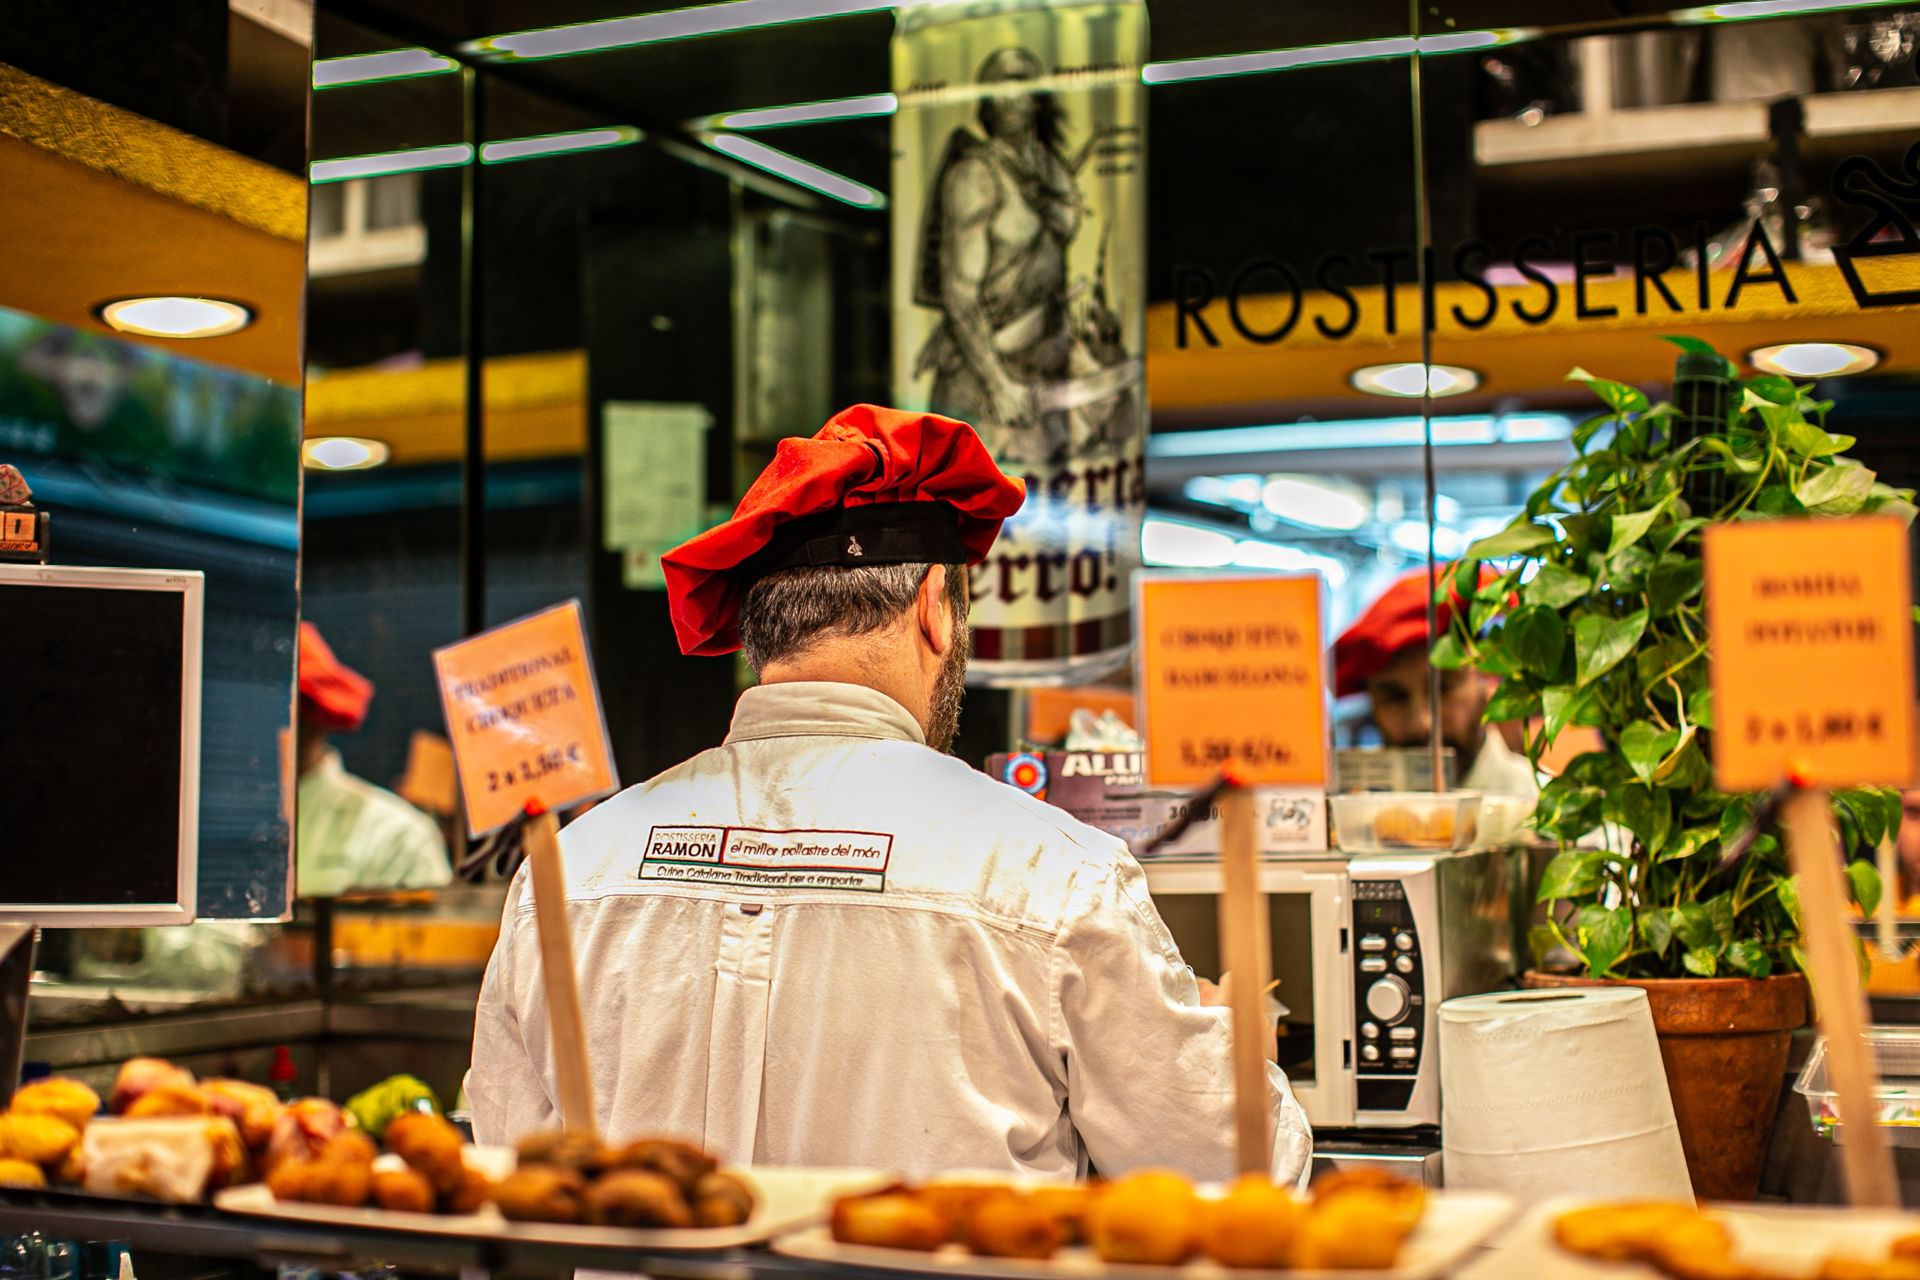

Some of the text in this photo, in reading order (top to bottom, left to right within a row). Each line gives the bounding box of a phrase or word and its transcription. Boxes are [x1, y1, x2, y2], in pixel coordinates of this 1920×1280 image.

[1174, 218, 1800, 349] ROSTISSERIA
[655, 832, 716, 843] ROSTISSERIA
[652, 842, 716, 858] RAMON
[730, 841, 742, 853] el
[781, 843, 829, 858] pollastre
[831, 844, 851, 856] del
[852, 846, 880, 859] món
